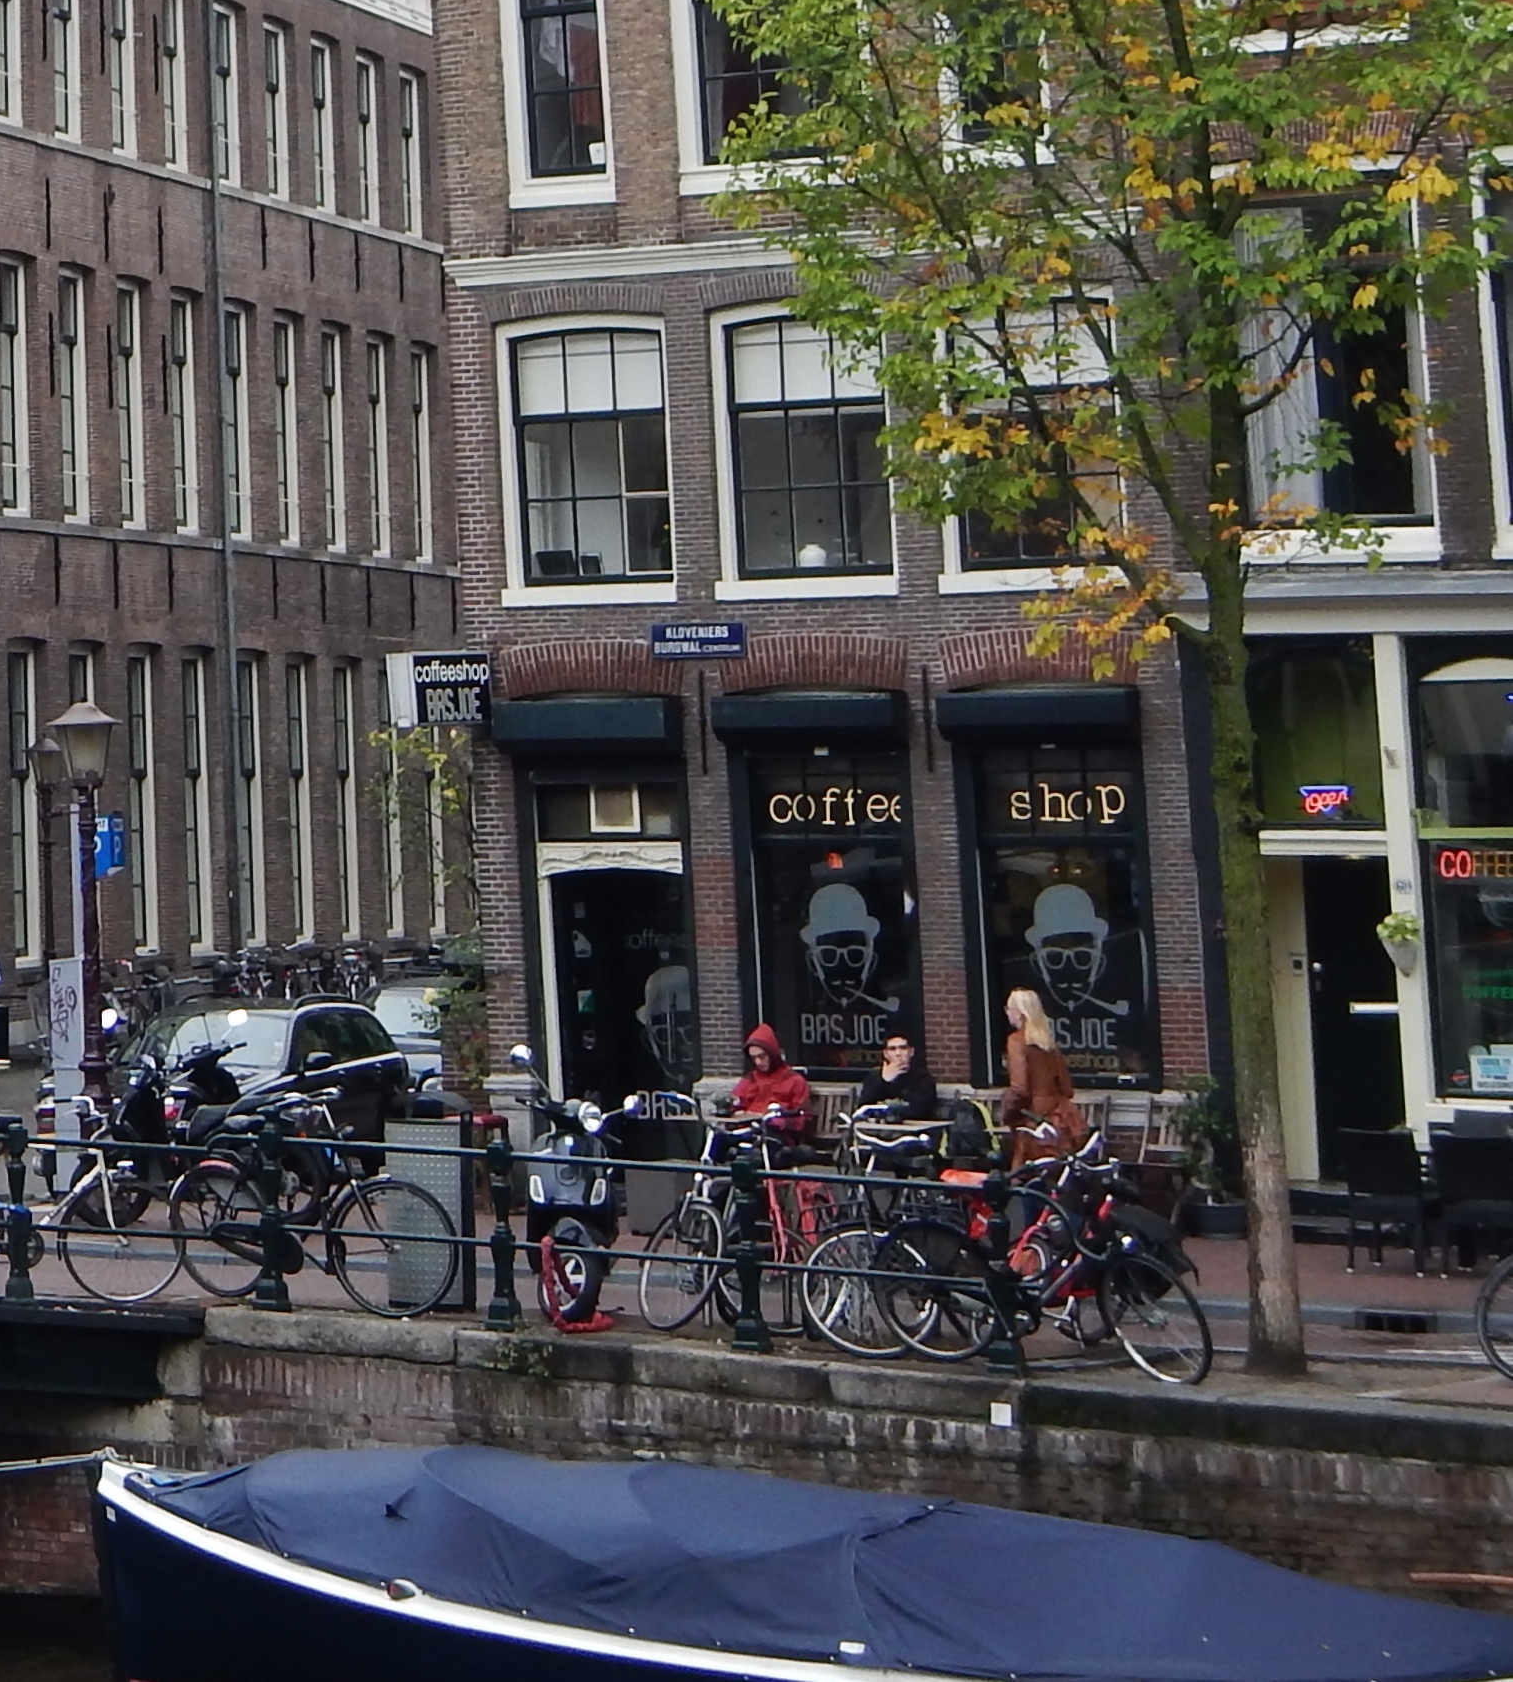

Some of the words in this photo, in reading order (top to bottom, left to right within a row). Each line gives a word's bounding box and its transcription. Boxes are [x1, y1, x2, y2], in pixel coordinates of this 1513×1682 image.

[665, 625, 729, 639] KLOVENIERS
[414, 658, 490, 685] coffeeshop
[769, 786, 902, 826] coffee
[1010, 782, 1126, 824] shop
[1305, 791, 1349, 814] Open
